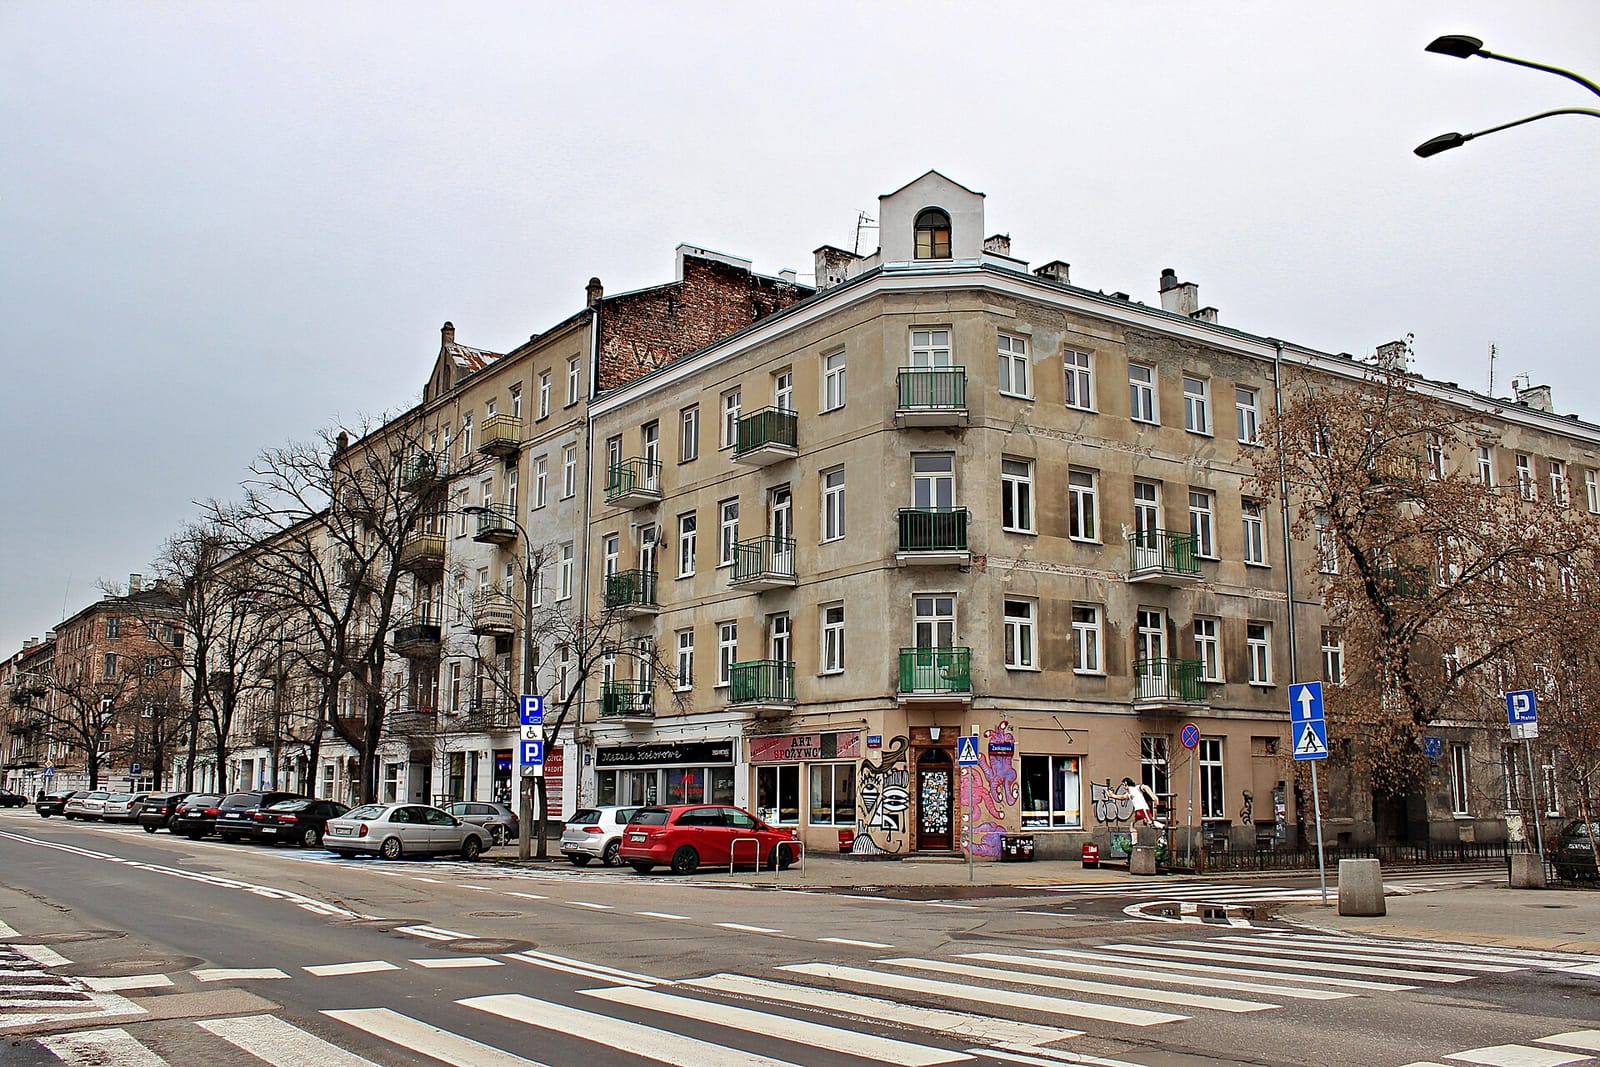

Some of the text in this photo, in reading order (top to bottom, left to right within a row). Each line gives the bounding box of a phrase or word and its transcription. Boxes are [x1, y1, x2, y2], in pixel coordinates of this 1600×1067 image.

[525, 697, 539, 717] P
[1512, 694, 1530, 720] P
[790, 736, 813, 747] ART.
[525, 743, 539, 763] P
[601, 752, 636, 762] Metale
[774, 747, 821, 759] SPOŻYWC
[132, 763, 141, 773] P
